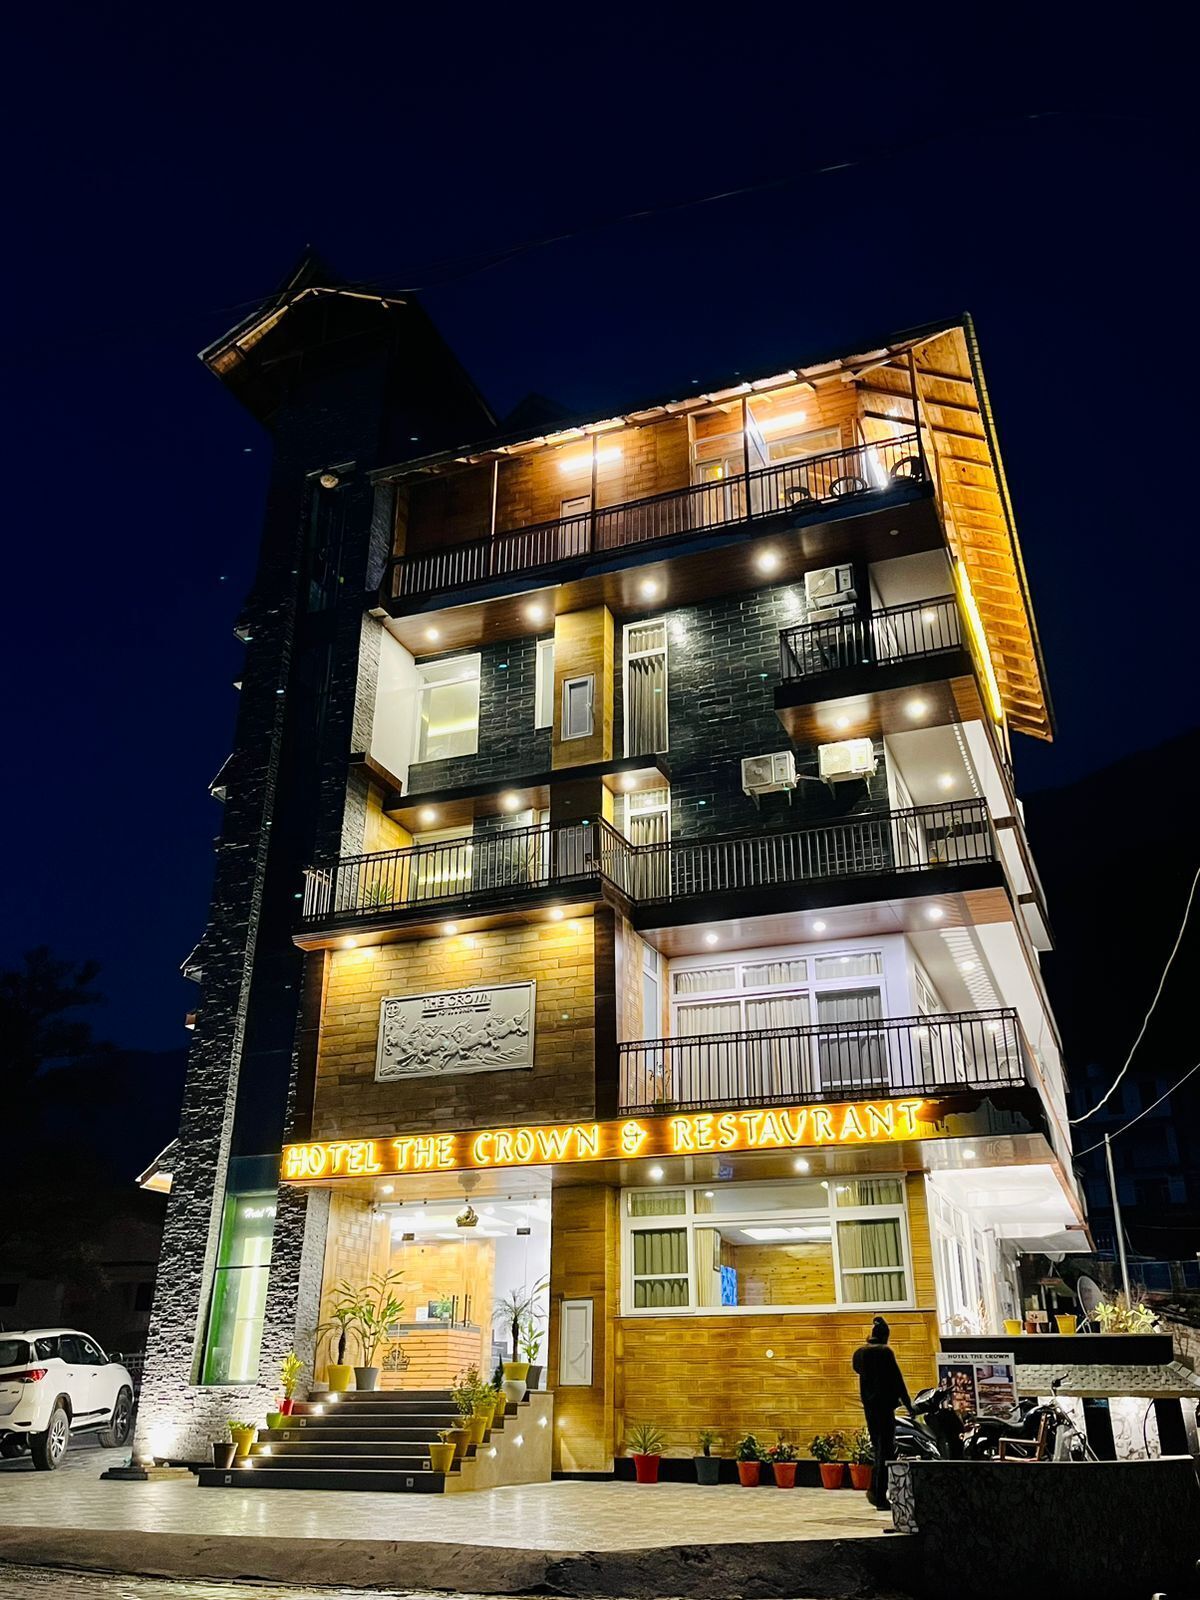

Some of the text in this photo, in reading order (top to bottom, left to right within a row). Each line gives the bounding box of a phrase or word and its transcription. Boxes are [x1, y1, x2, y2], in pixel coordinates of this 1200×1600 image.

[285, 1100, 924, 1178] HOTEL THE CROWN & RESTAURANT
